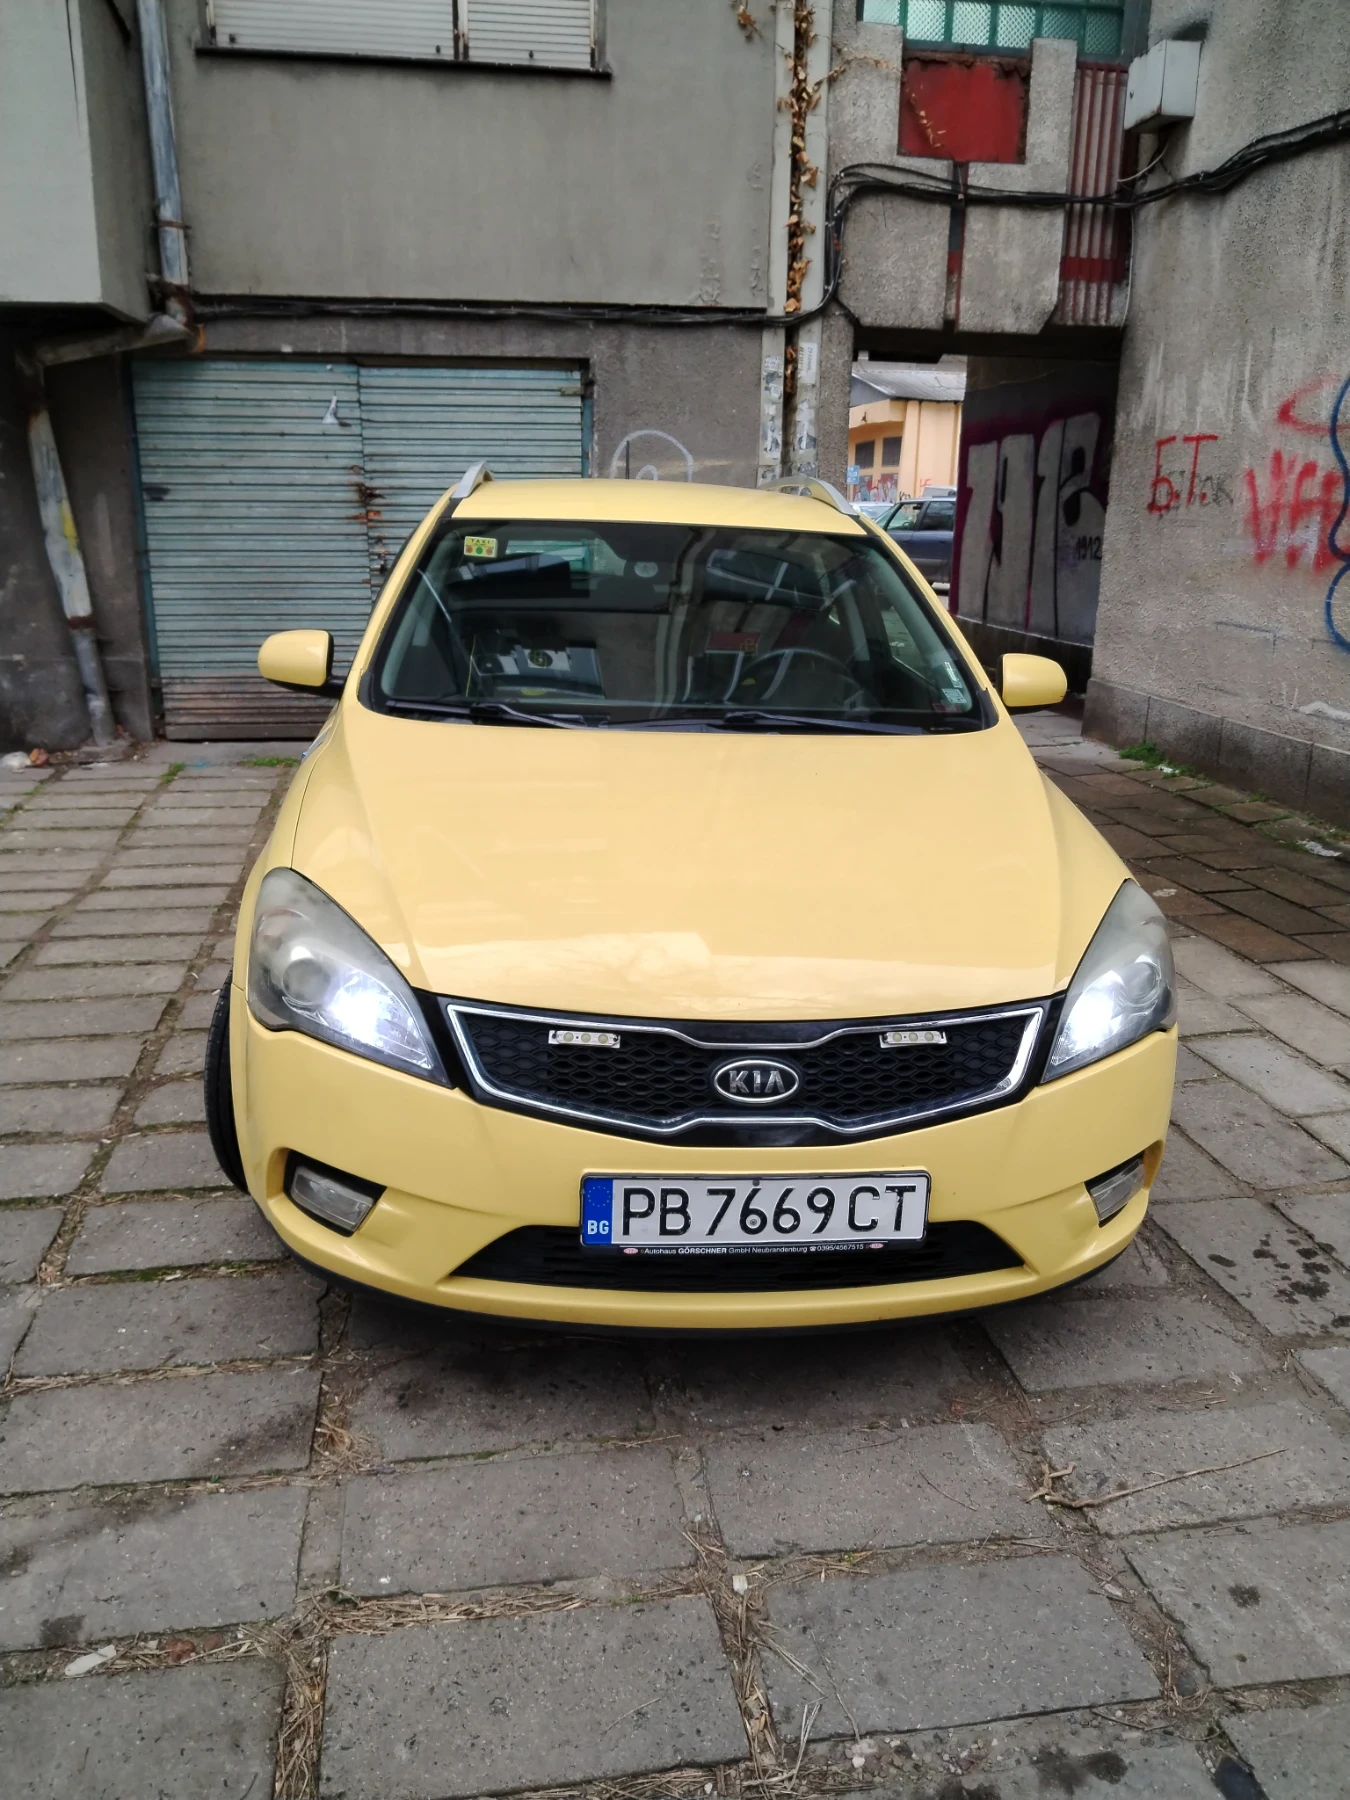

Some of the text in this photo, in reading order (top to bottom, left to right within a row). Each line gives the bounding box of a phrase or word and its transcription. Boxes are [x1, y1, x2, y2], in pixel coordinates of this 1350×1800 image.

[1075, 536, 1102, 560] 1912
[728, 1070, 786, 1093] KIA
[622, 1185, 917, 1236] PB 7669 CT
[587, 1220, 610, 1235] BG
[644, 1247, 677, 1255] Autohaus
[678, 1246, 727, 1255] GÖRSCHNER
[752, 1245, 808, 1254] Neubrandenburg
